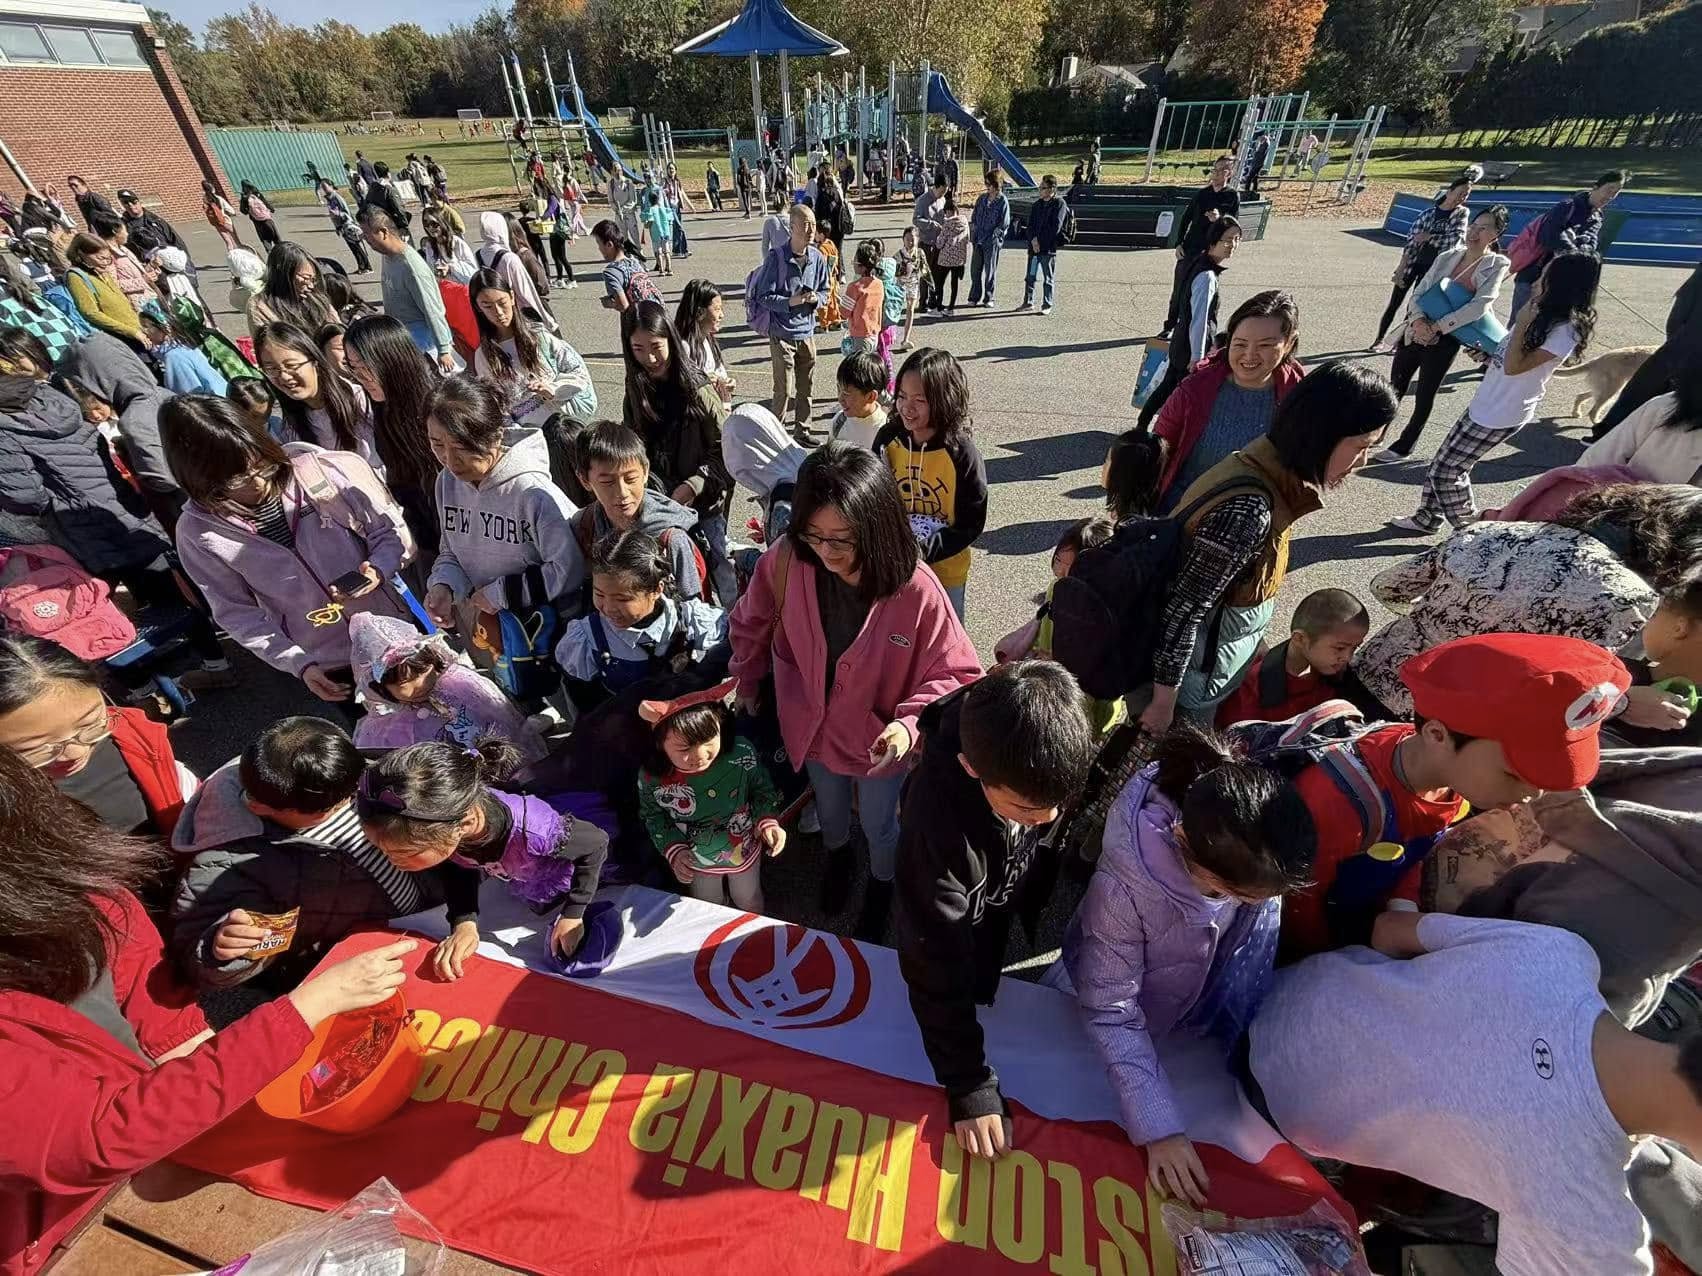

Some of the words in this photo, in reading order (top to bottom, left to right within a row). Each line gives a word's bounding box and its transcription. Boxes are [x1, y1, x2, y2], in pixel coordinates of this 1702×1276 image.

[444, 506, 471, 534] EW
[480, 511, 535, 545] YORK
[628, 1062, 917, 1252] Huaxia
